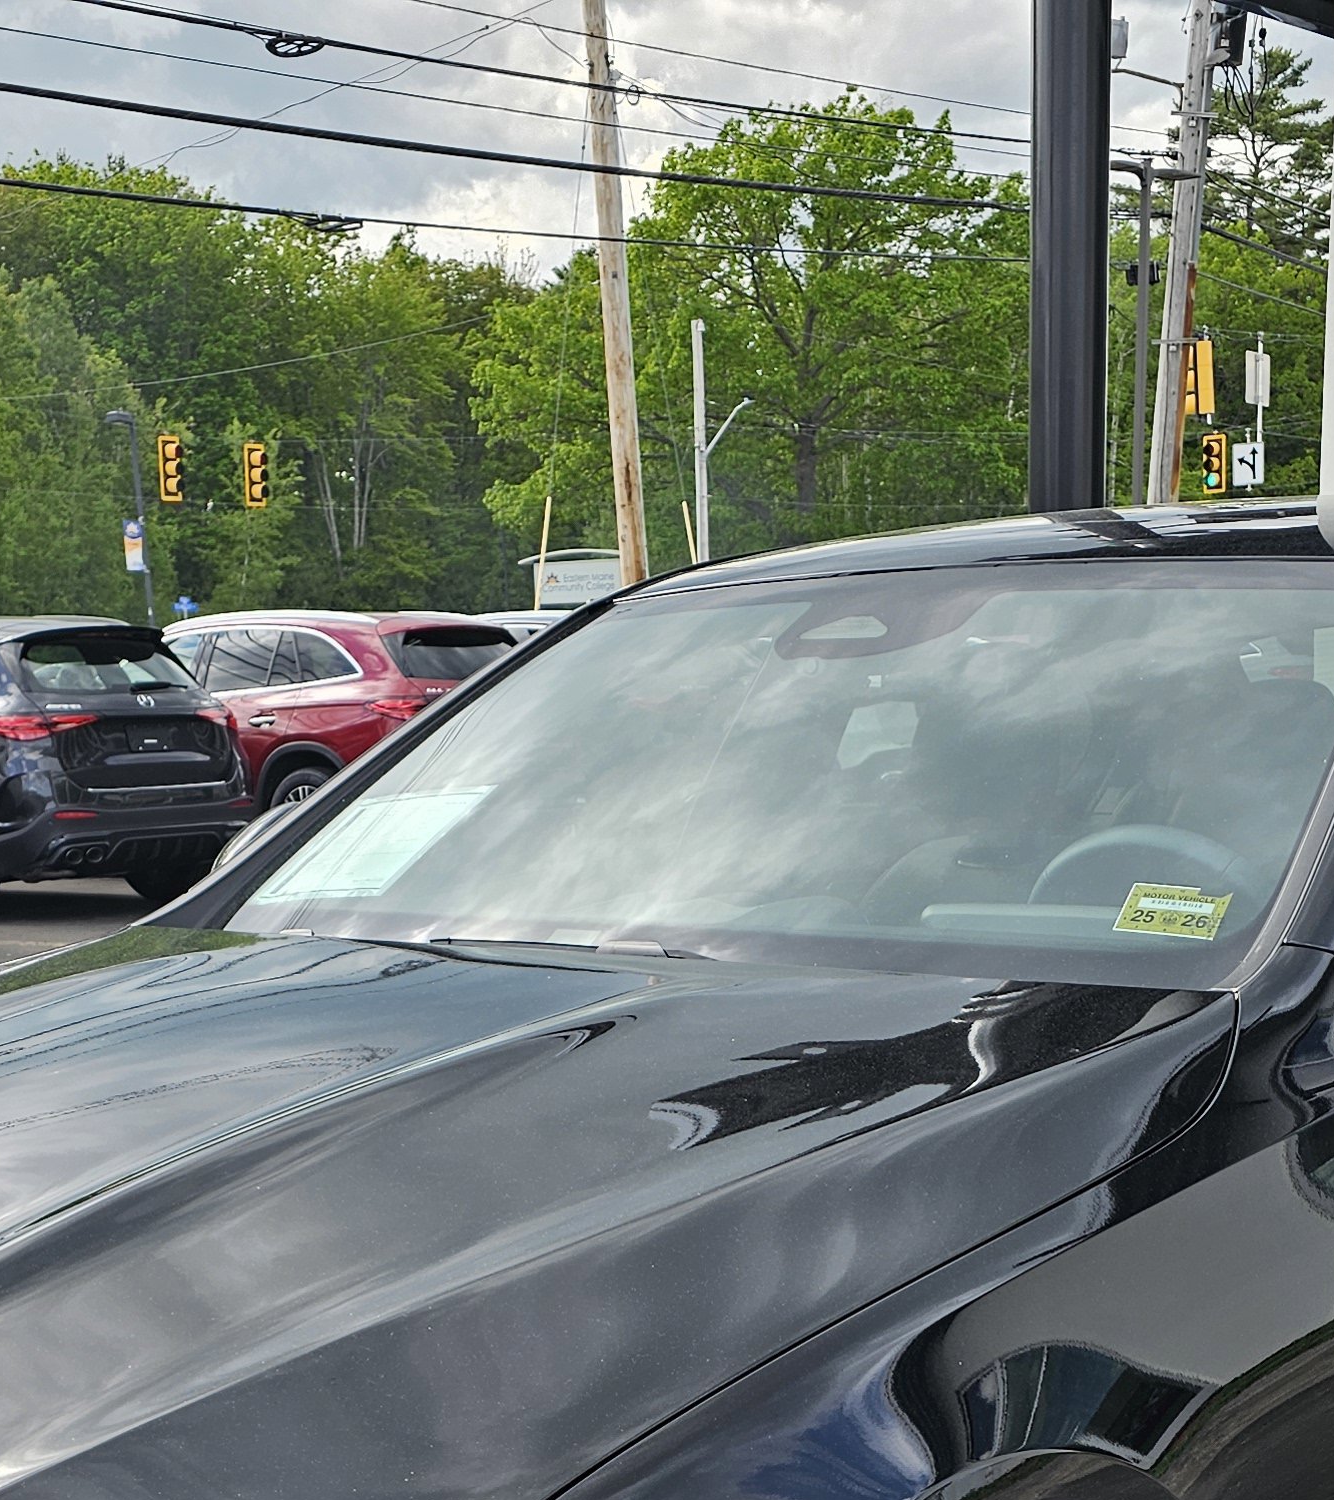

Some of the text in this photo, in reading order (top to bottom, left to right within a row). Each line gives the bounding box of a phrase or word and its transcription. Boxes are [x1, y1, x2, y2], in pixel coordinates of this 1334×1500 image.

[592, 572, 615, 581] Maine
[542, 581, 616, 593] Community College
[1142, 892, 1176, 901] MOTOR
[1178, 895, 1216, 904] VEHICLE
[1130, 909, 1210, 929] 25 26
